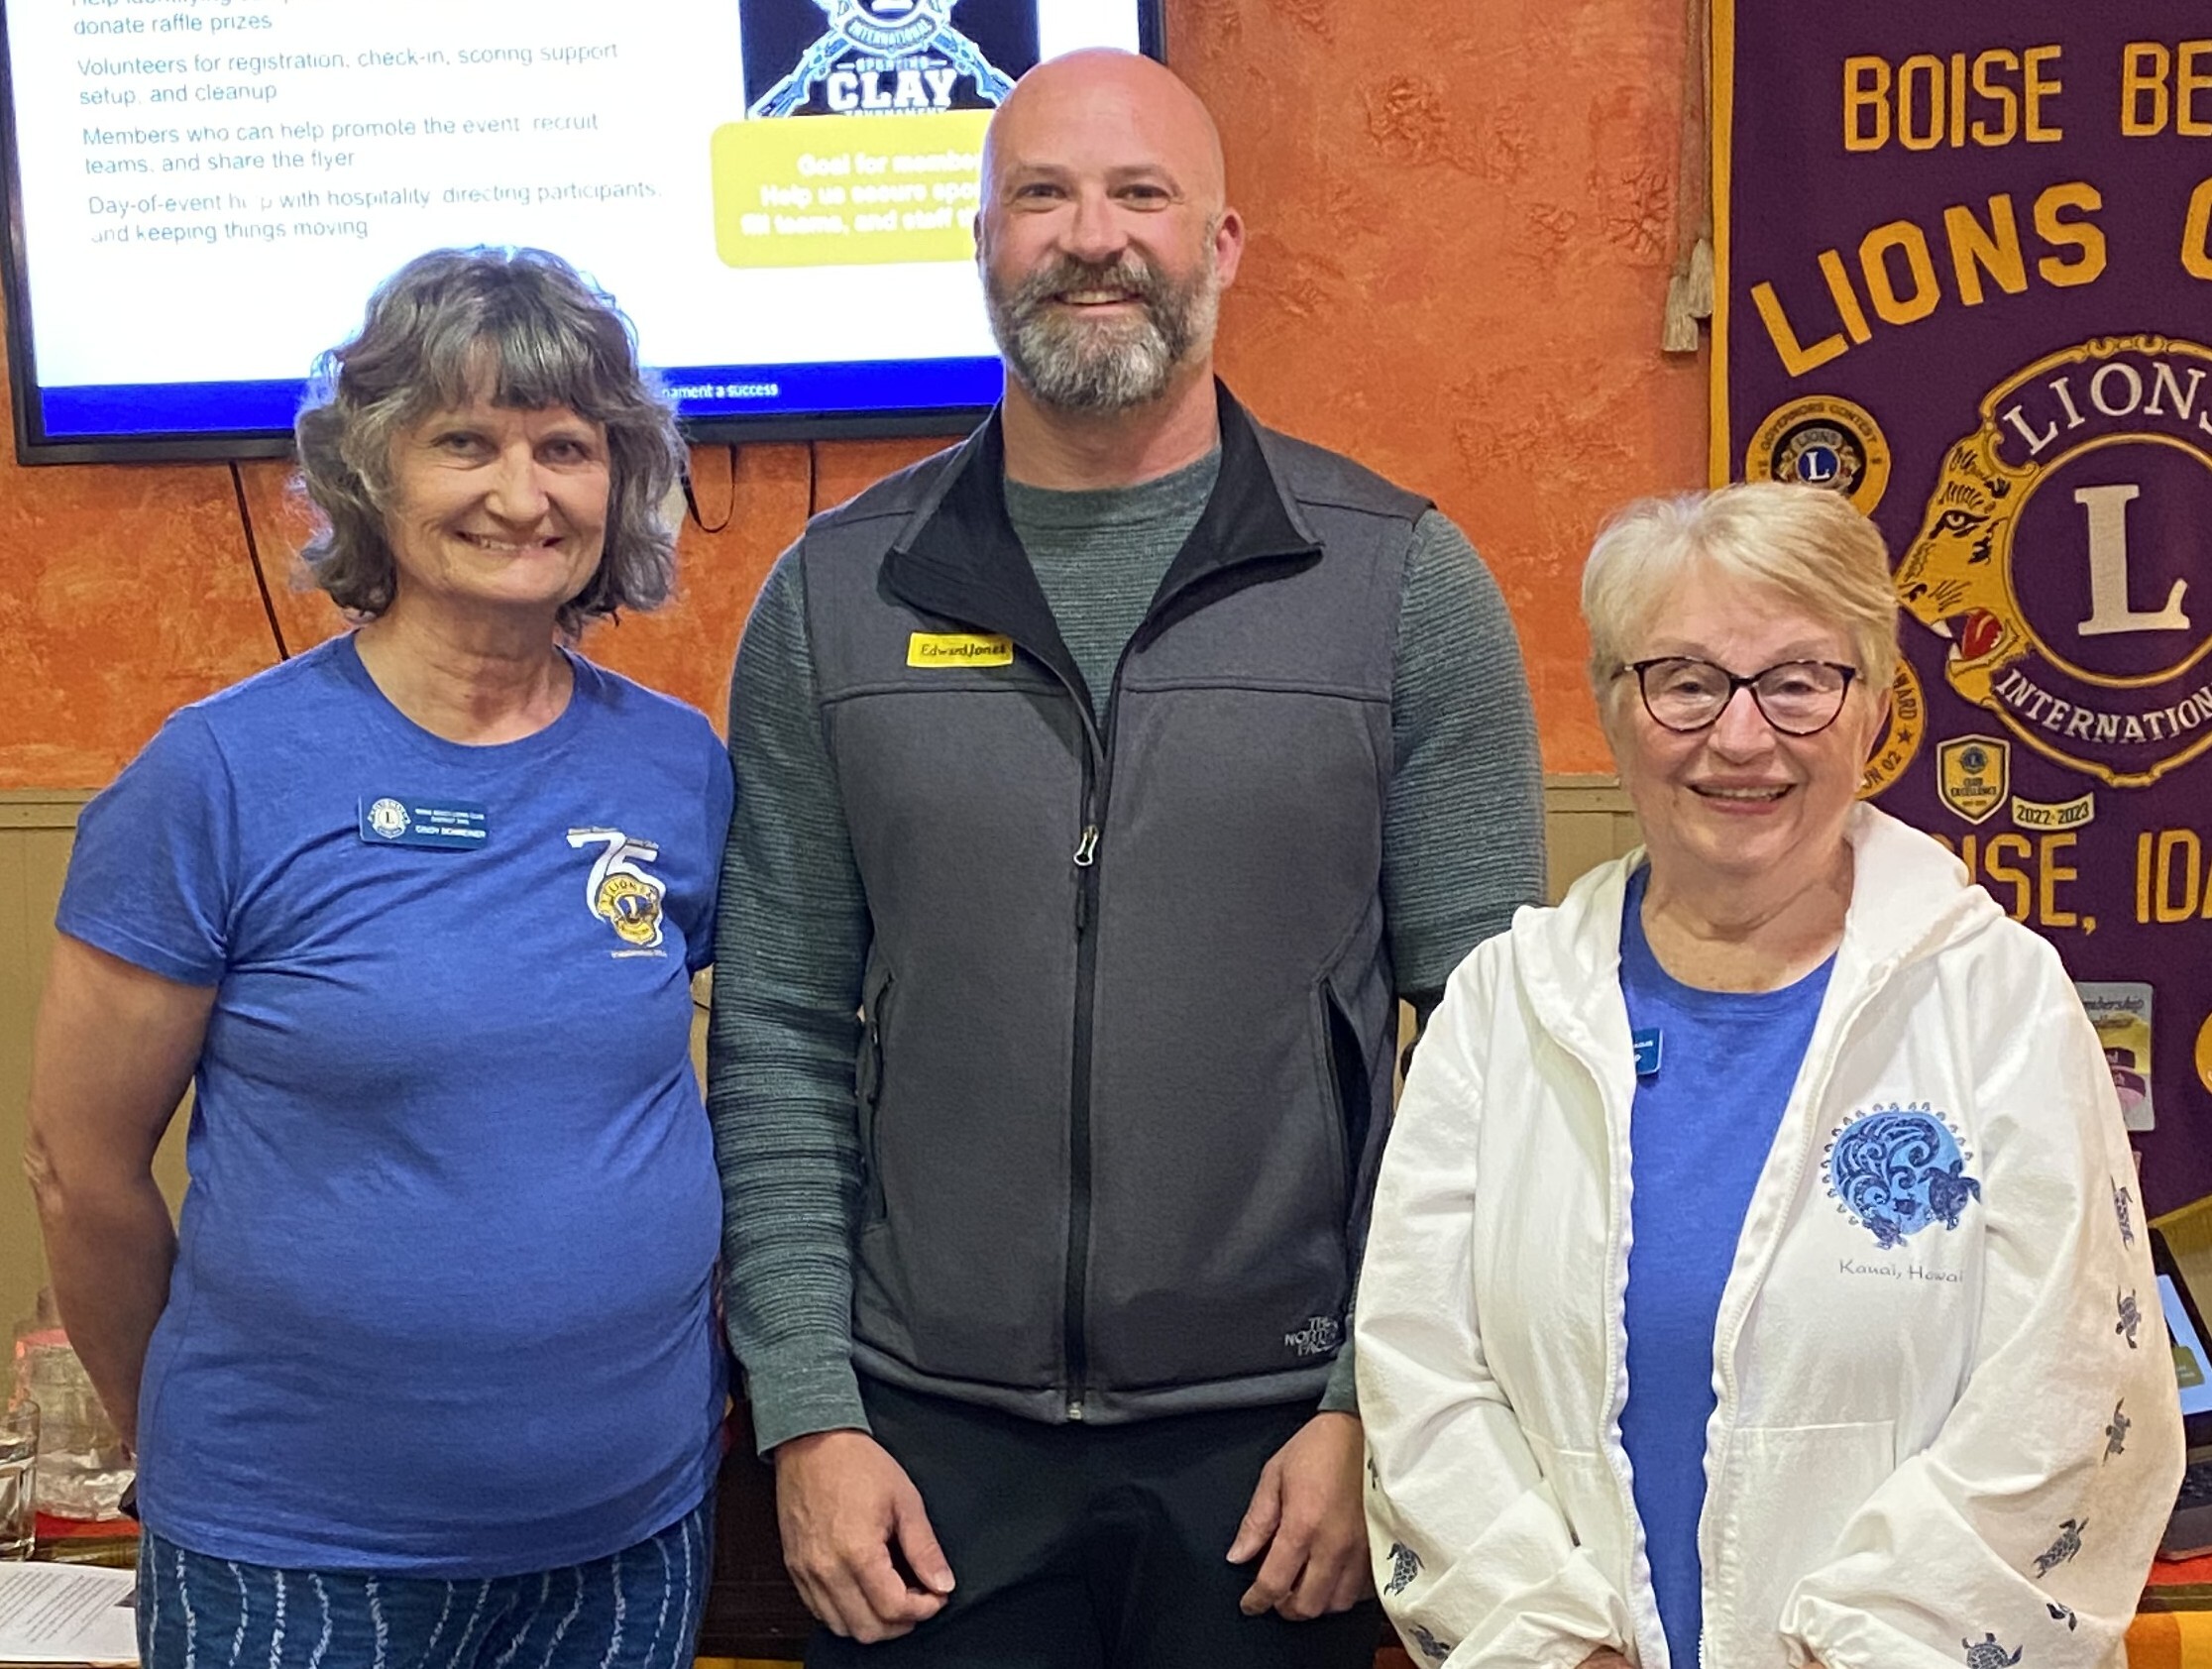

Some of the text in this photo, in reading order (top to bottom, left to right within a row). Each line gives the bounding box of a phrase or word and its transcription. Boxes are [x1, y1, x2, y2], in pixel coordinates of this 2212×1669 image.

[74, 13, 273, 35] donate raffle prizes
[77, 57, 187, 76] Volunteers
[194, 55, 220, 73] for
[459, 48, 532, 66] scoring
[151, 84, 187, 102] and
[195, 83, 276, 103] cleanup
[827, 68, 957, 111] CLAY
[1844, 40, 2212, 152] BOISE BE
[83, 126, 178, 145] Members
[186, 125, 229, 143] who
[237, 125, 274, 141] can
[280, 122, 324, 142] help
[332, 118, 415, 141] promote
[424, 117, 455, 135] the
[163, 154, 200, 171] and
[208, 153, 265, 169] share
[273, 151, 304, 167] the
[311, 150, 355, 170] flyer
[798, 154, 850, 176] Goal
[855, 152, 888, 173] for
[89, 194, 221, 218] Day-of-event
[229, 192, 273, 211] hp
[279, 190, 319, 208] with
[443, 185, 530, 205] directing
[91, 220, 368, 245] and keeping things moving
[1751, 182, 2107, 378] LIONS
[726, 384, 778, 397] success
[1806, 451, 1830, 481] L
[2074, 485, 2190, 635] L
[1893, 668, 1919, 721] WARD
[1996, 668, 2212, 743] INTERNATION
[1934, 829, 2212, 936] ISE, ID
[1839, 1258, 1902, 1280] Kauai,
